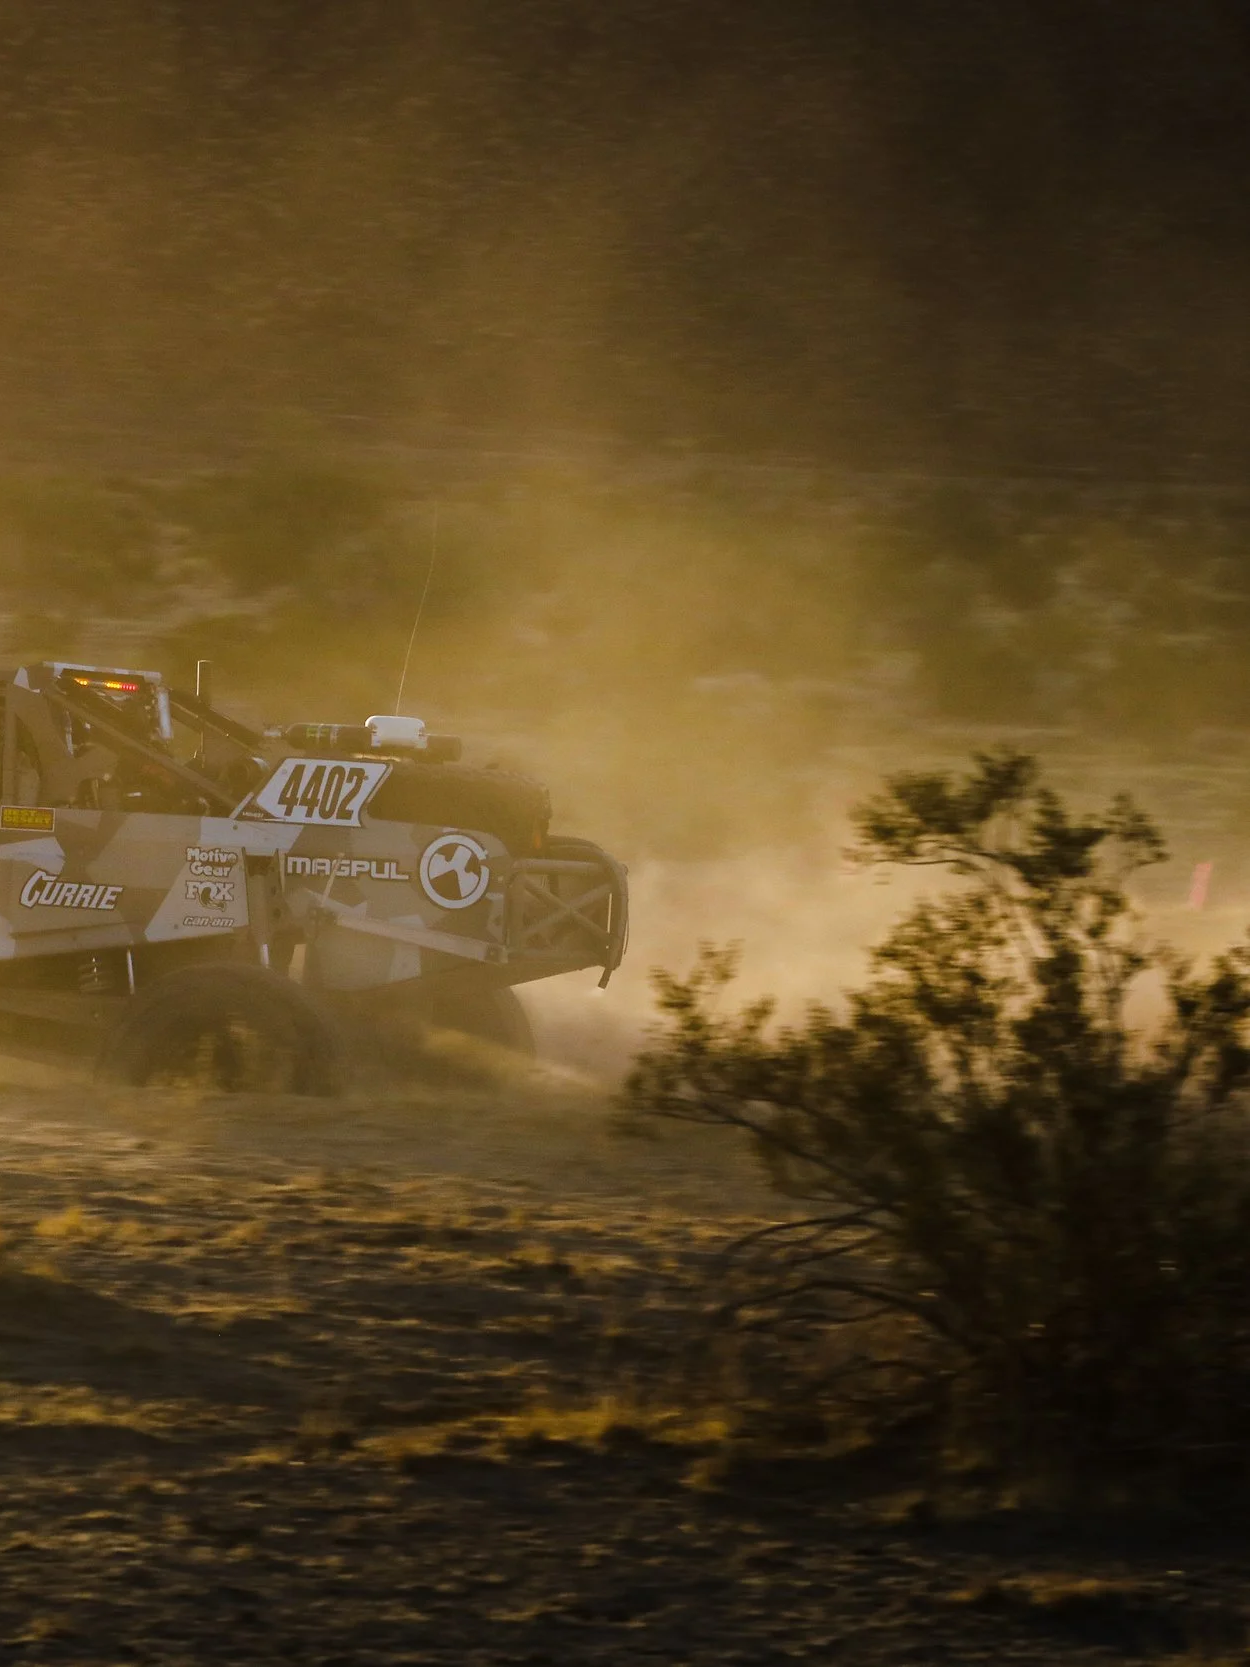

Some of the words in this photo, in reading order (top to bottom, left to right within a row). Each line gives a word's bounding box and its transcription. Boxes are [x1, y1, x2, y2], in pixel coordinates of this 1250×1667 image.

[278, 763, 366, 820] 4402
[186, 846, 238, 863] Motive
[190, 861, 231, 878] Gear
[287, 856, 409, 880] MAGPUL
[19, 869, 124, 909] CURRIE
[185, 880, 234, 908] FOX
